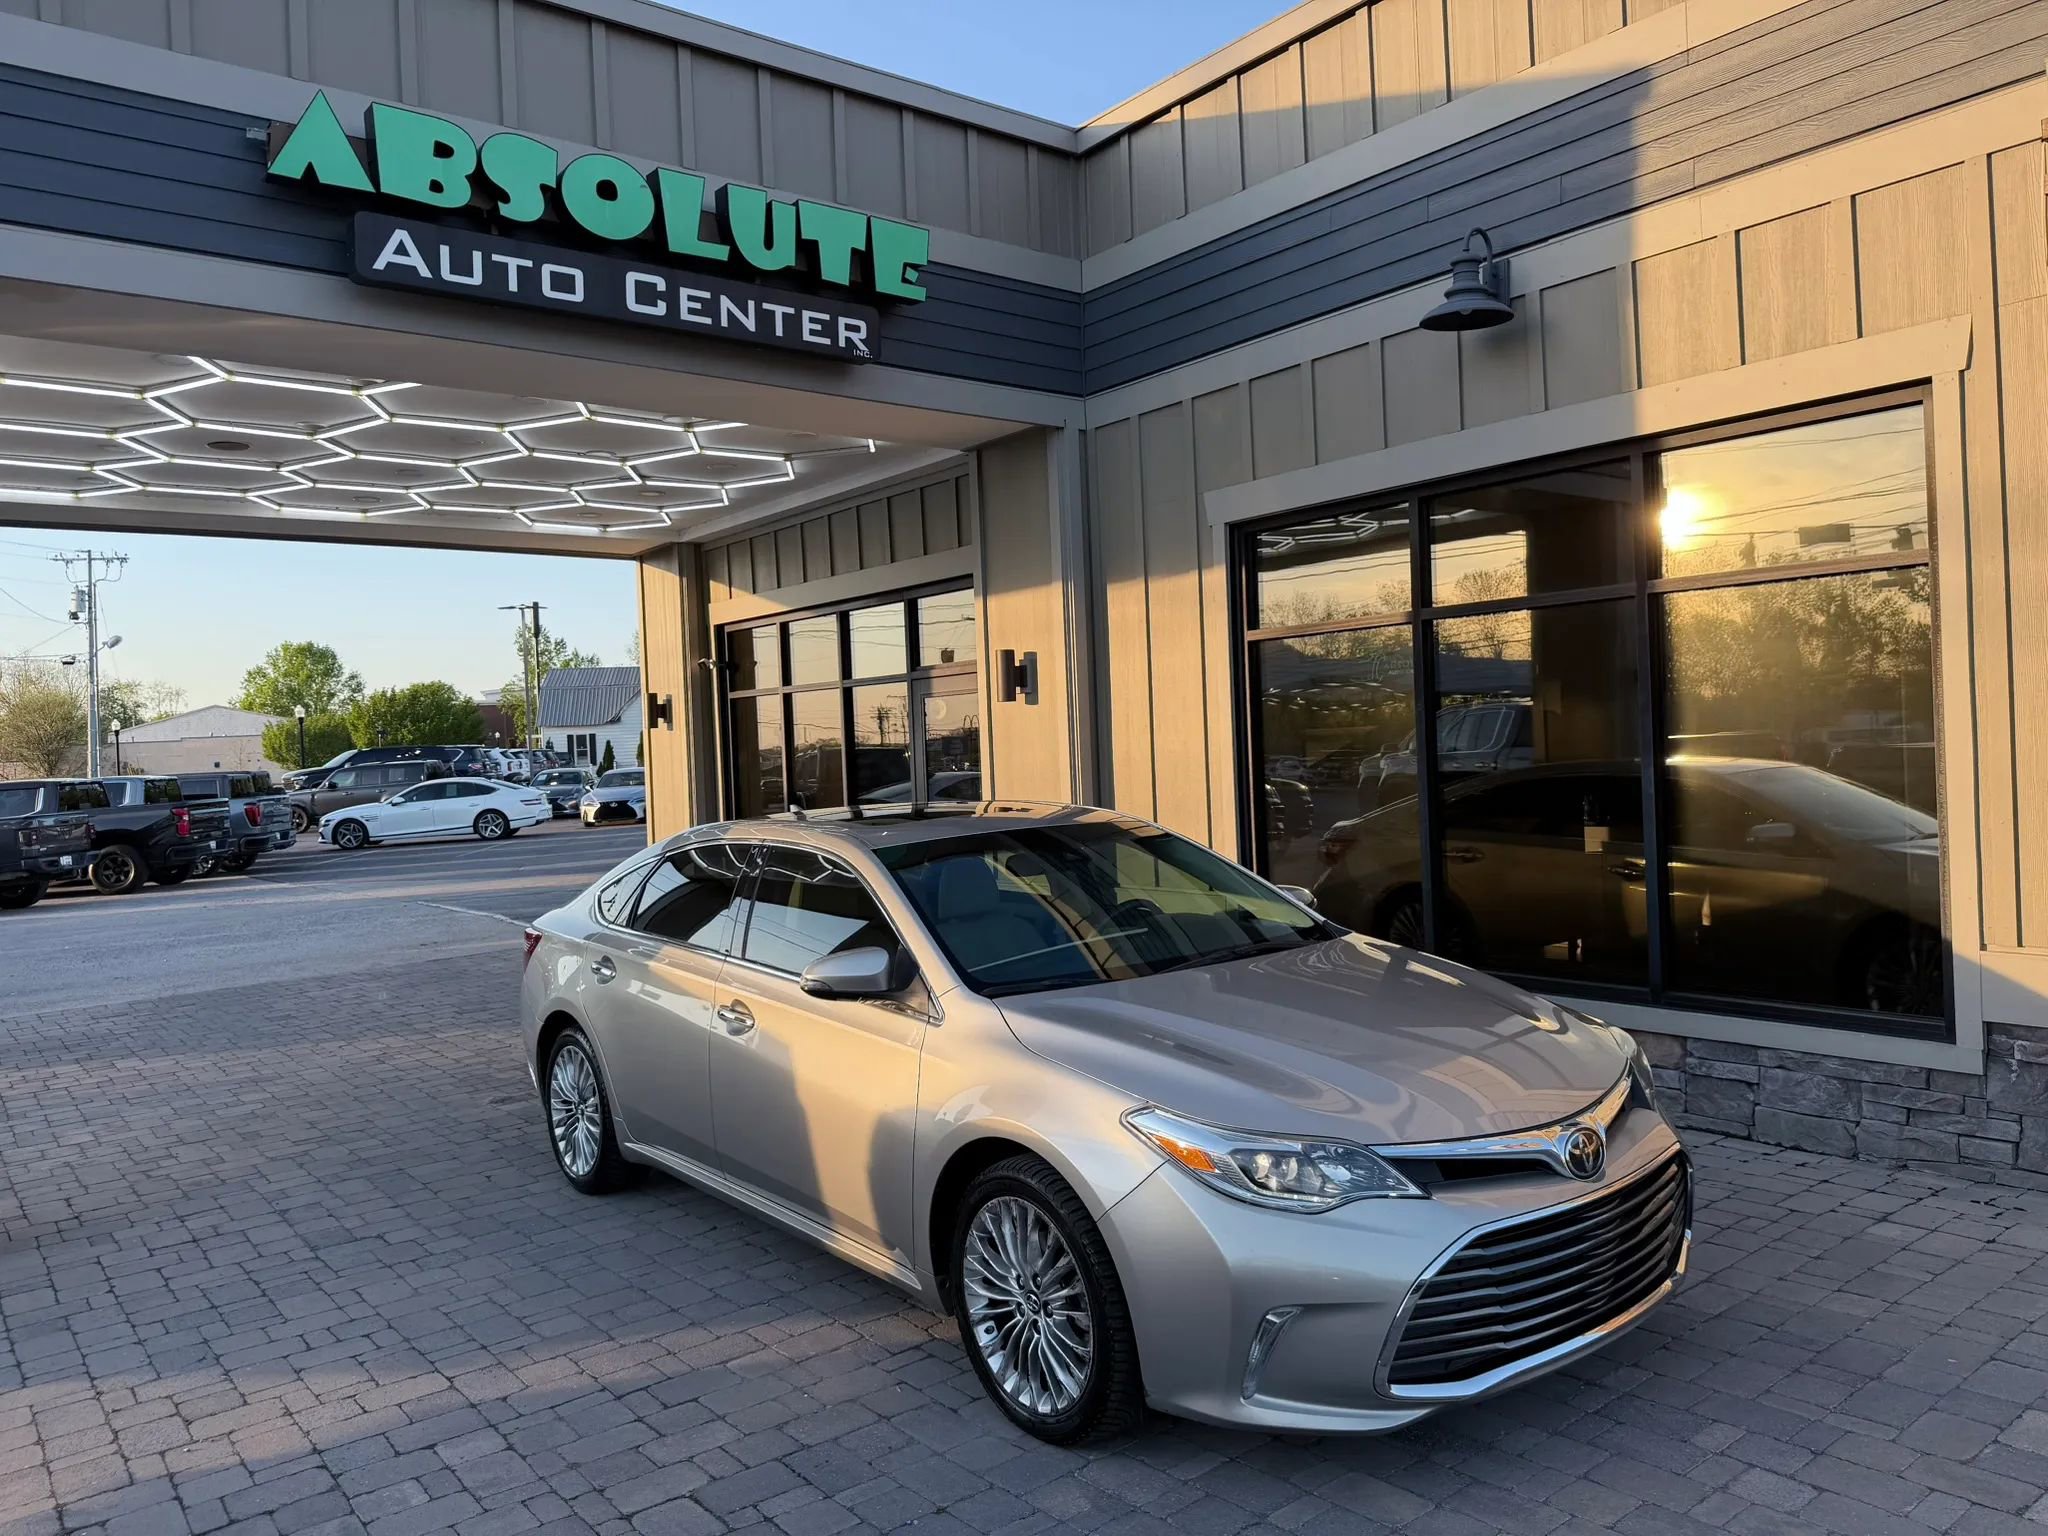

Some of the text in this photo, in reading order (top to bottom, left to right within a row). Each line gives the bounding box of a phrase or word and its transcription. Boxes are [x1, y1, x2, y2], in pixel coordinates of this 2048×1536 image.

[267, 89, 930, 302] ABSOLUTE
[372, 228, 869, 352] AUTO CENTER
[853, 348, 873, 359] INC.
